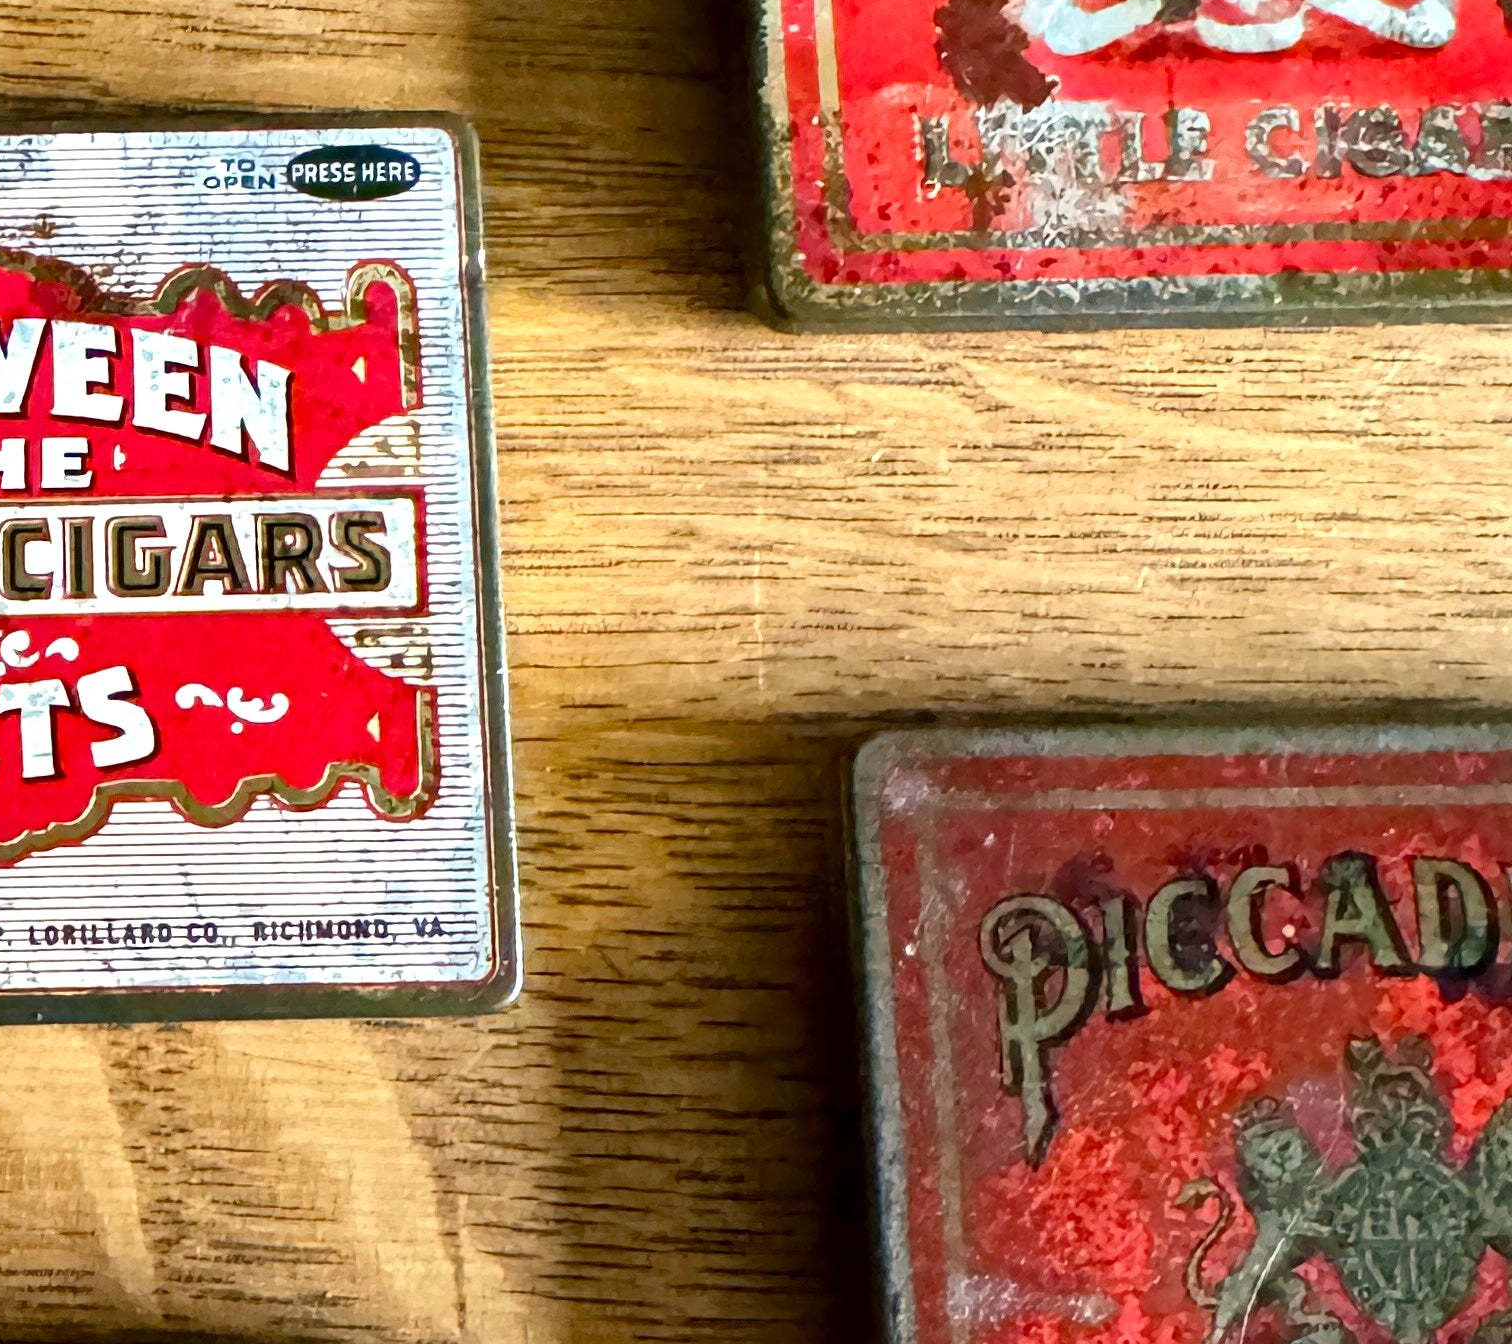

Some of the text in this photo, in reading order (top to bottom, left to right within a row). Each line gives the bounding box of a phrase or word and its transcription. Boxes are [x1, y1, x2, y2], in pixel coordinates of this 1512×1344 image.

[220, 159, 256, 172] TO
[291, 161, 416, 185] PRESS HERE
[202, 173, 276, 190] OPEN
[28, 924, 173, 945] LORILLARD
[253, 919, 397, 944] RICHMOND,
